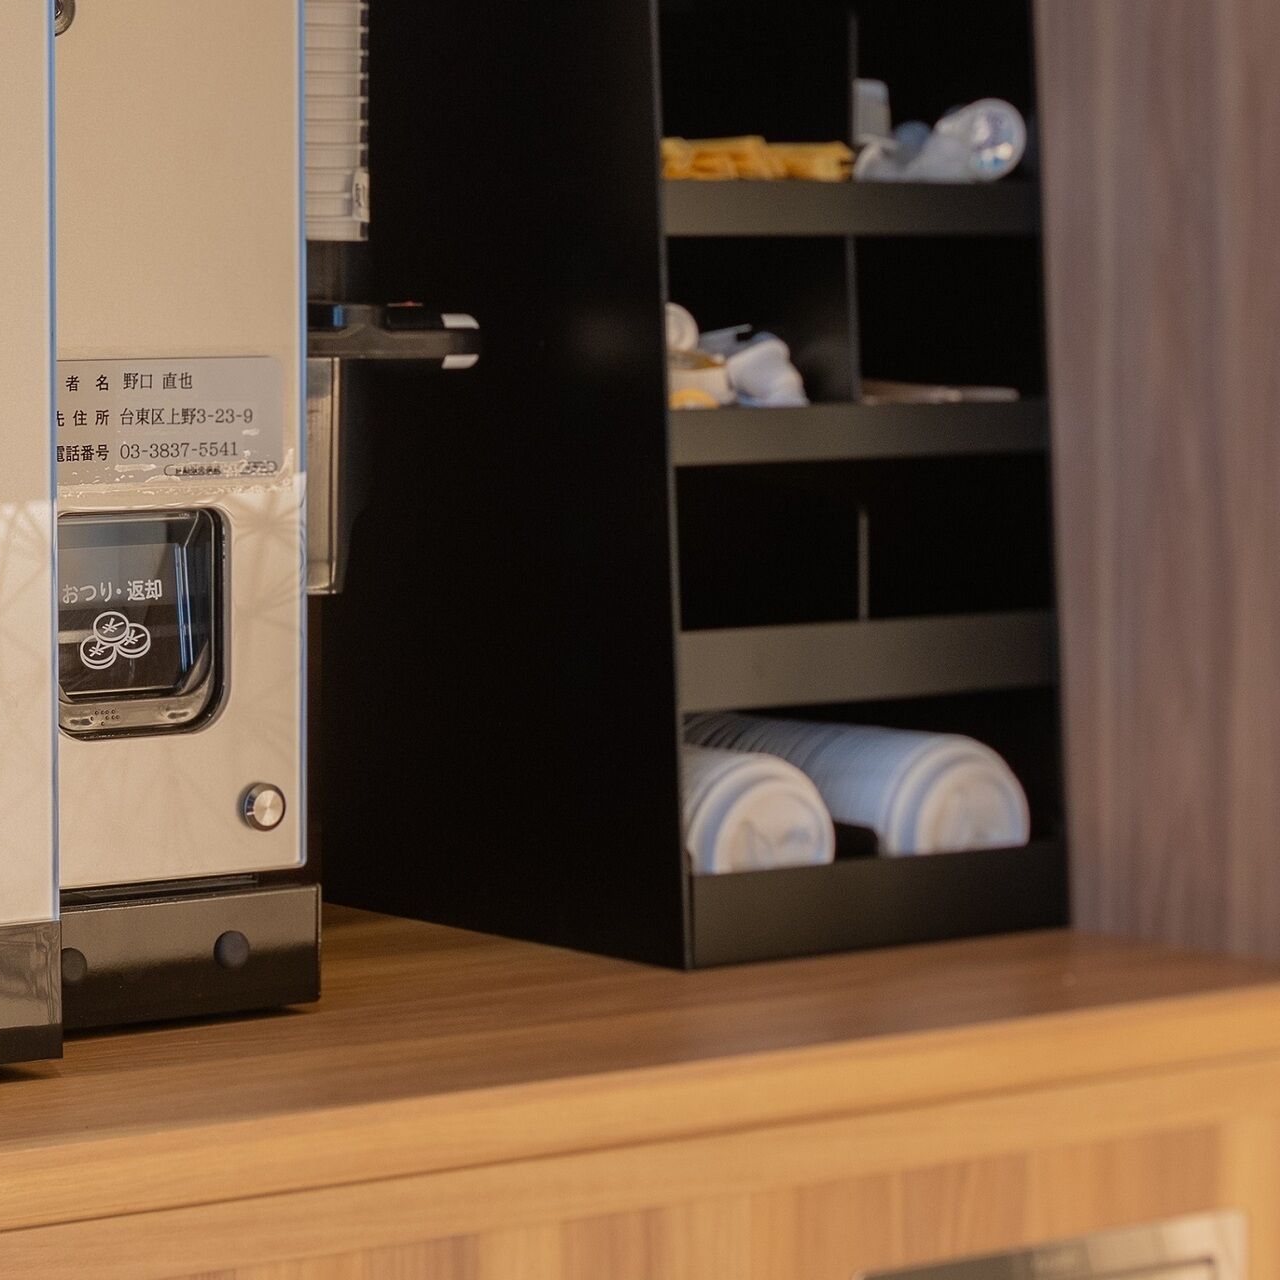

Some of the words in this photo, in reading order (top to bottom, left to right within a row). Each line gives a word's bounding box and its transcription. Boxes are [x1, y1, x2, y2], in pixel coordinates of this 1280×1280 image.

[123, 372, 153, 390] 野口
[162, 371, 193, 390] 直也
[120, 407, 253, 426] 台東区上野3-23-9
[120, 442, 238, 460] 03-3837-5541
[62, 579, 163, 604] おつり・返却
